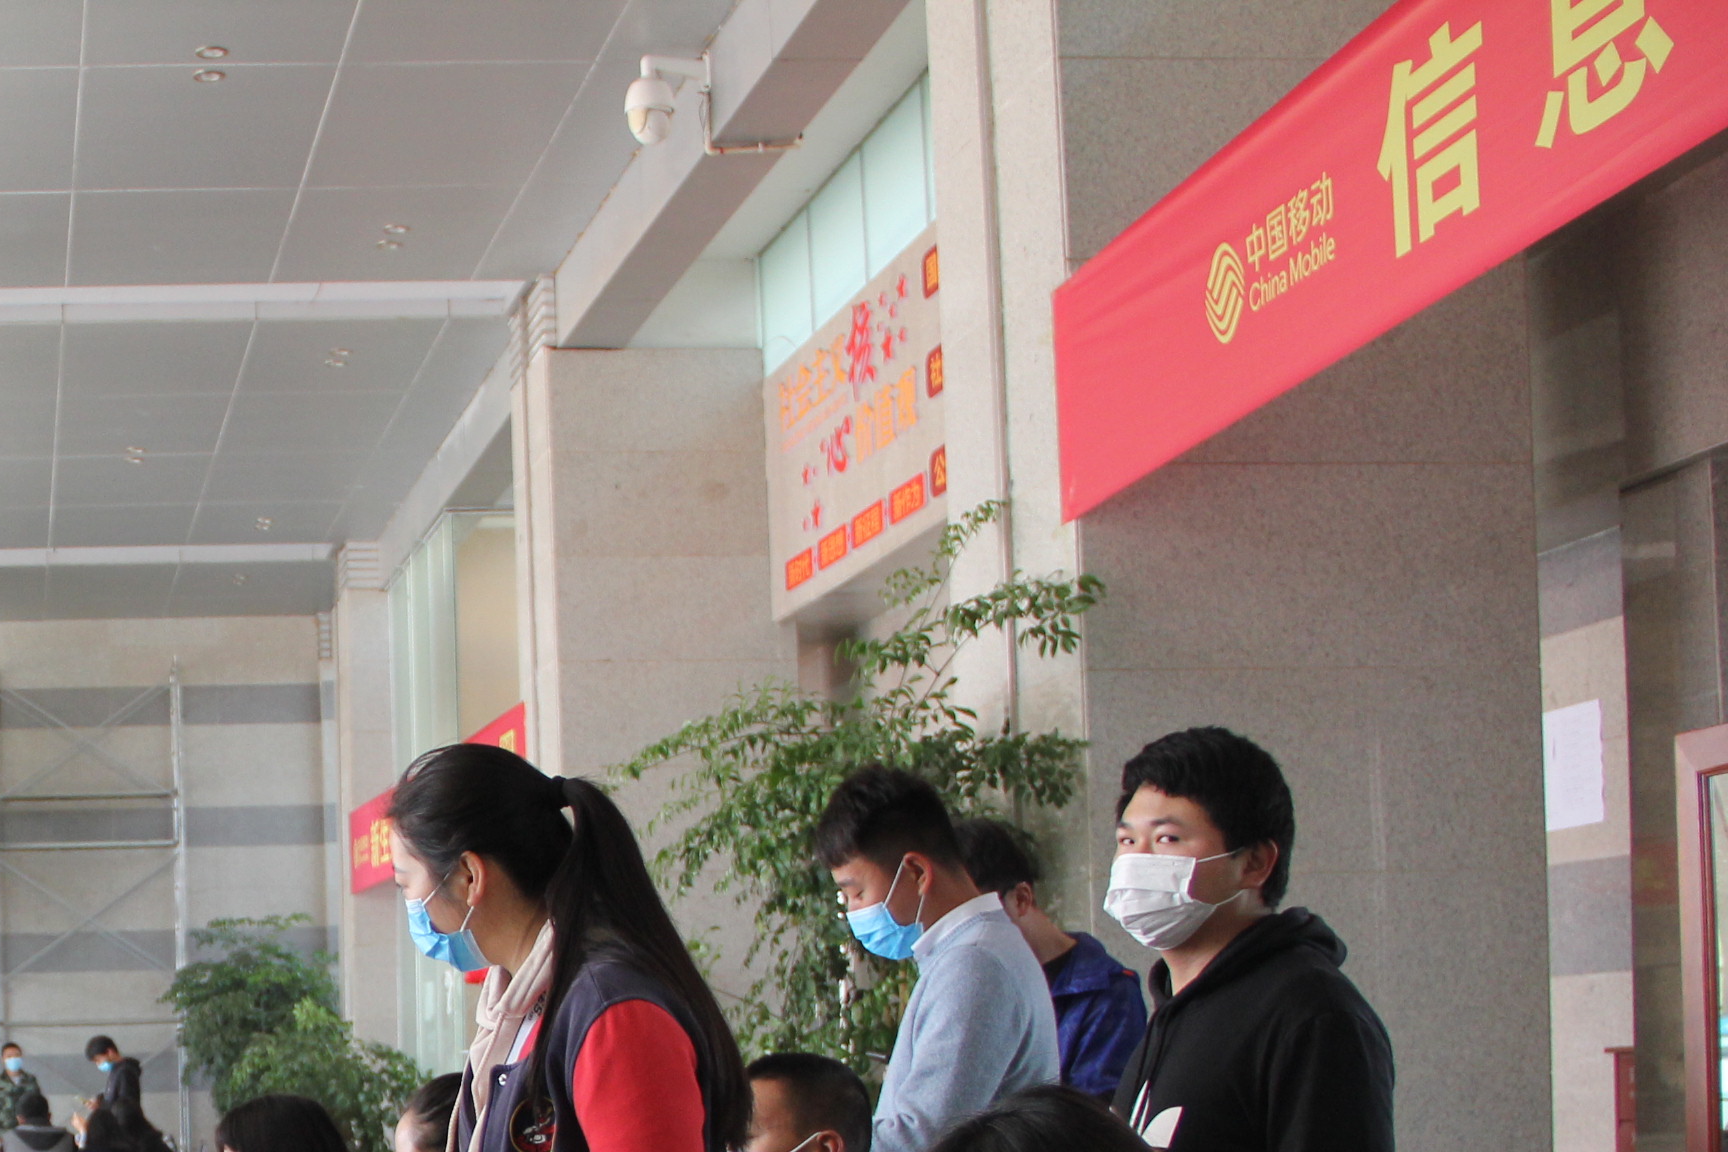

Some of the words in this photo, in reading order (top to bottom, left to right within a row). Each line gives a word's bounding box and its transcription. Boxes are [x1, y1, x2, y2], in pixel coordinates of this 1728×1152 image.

[1377, 0, 1674, 259] 信息
[1245, 171, 1334, 272] 中国移动
[1249, 269, 1289, 312] China
[1289, 231, 1336, 287] Mobile
